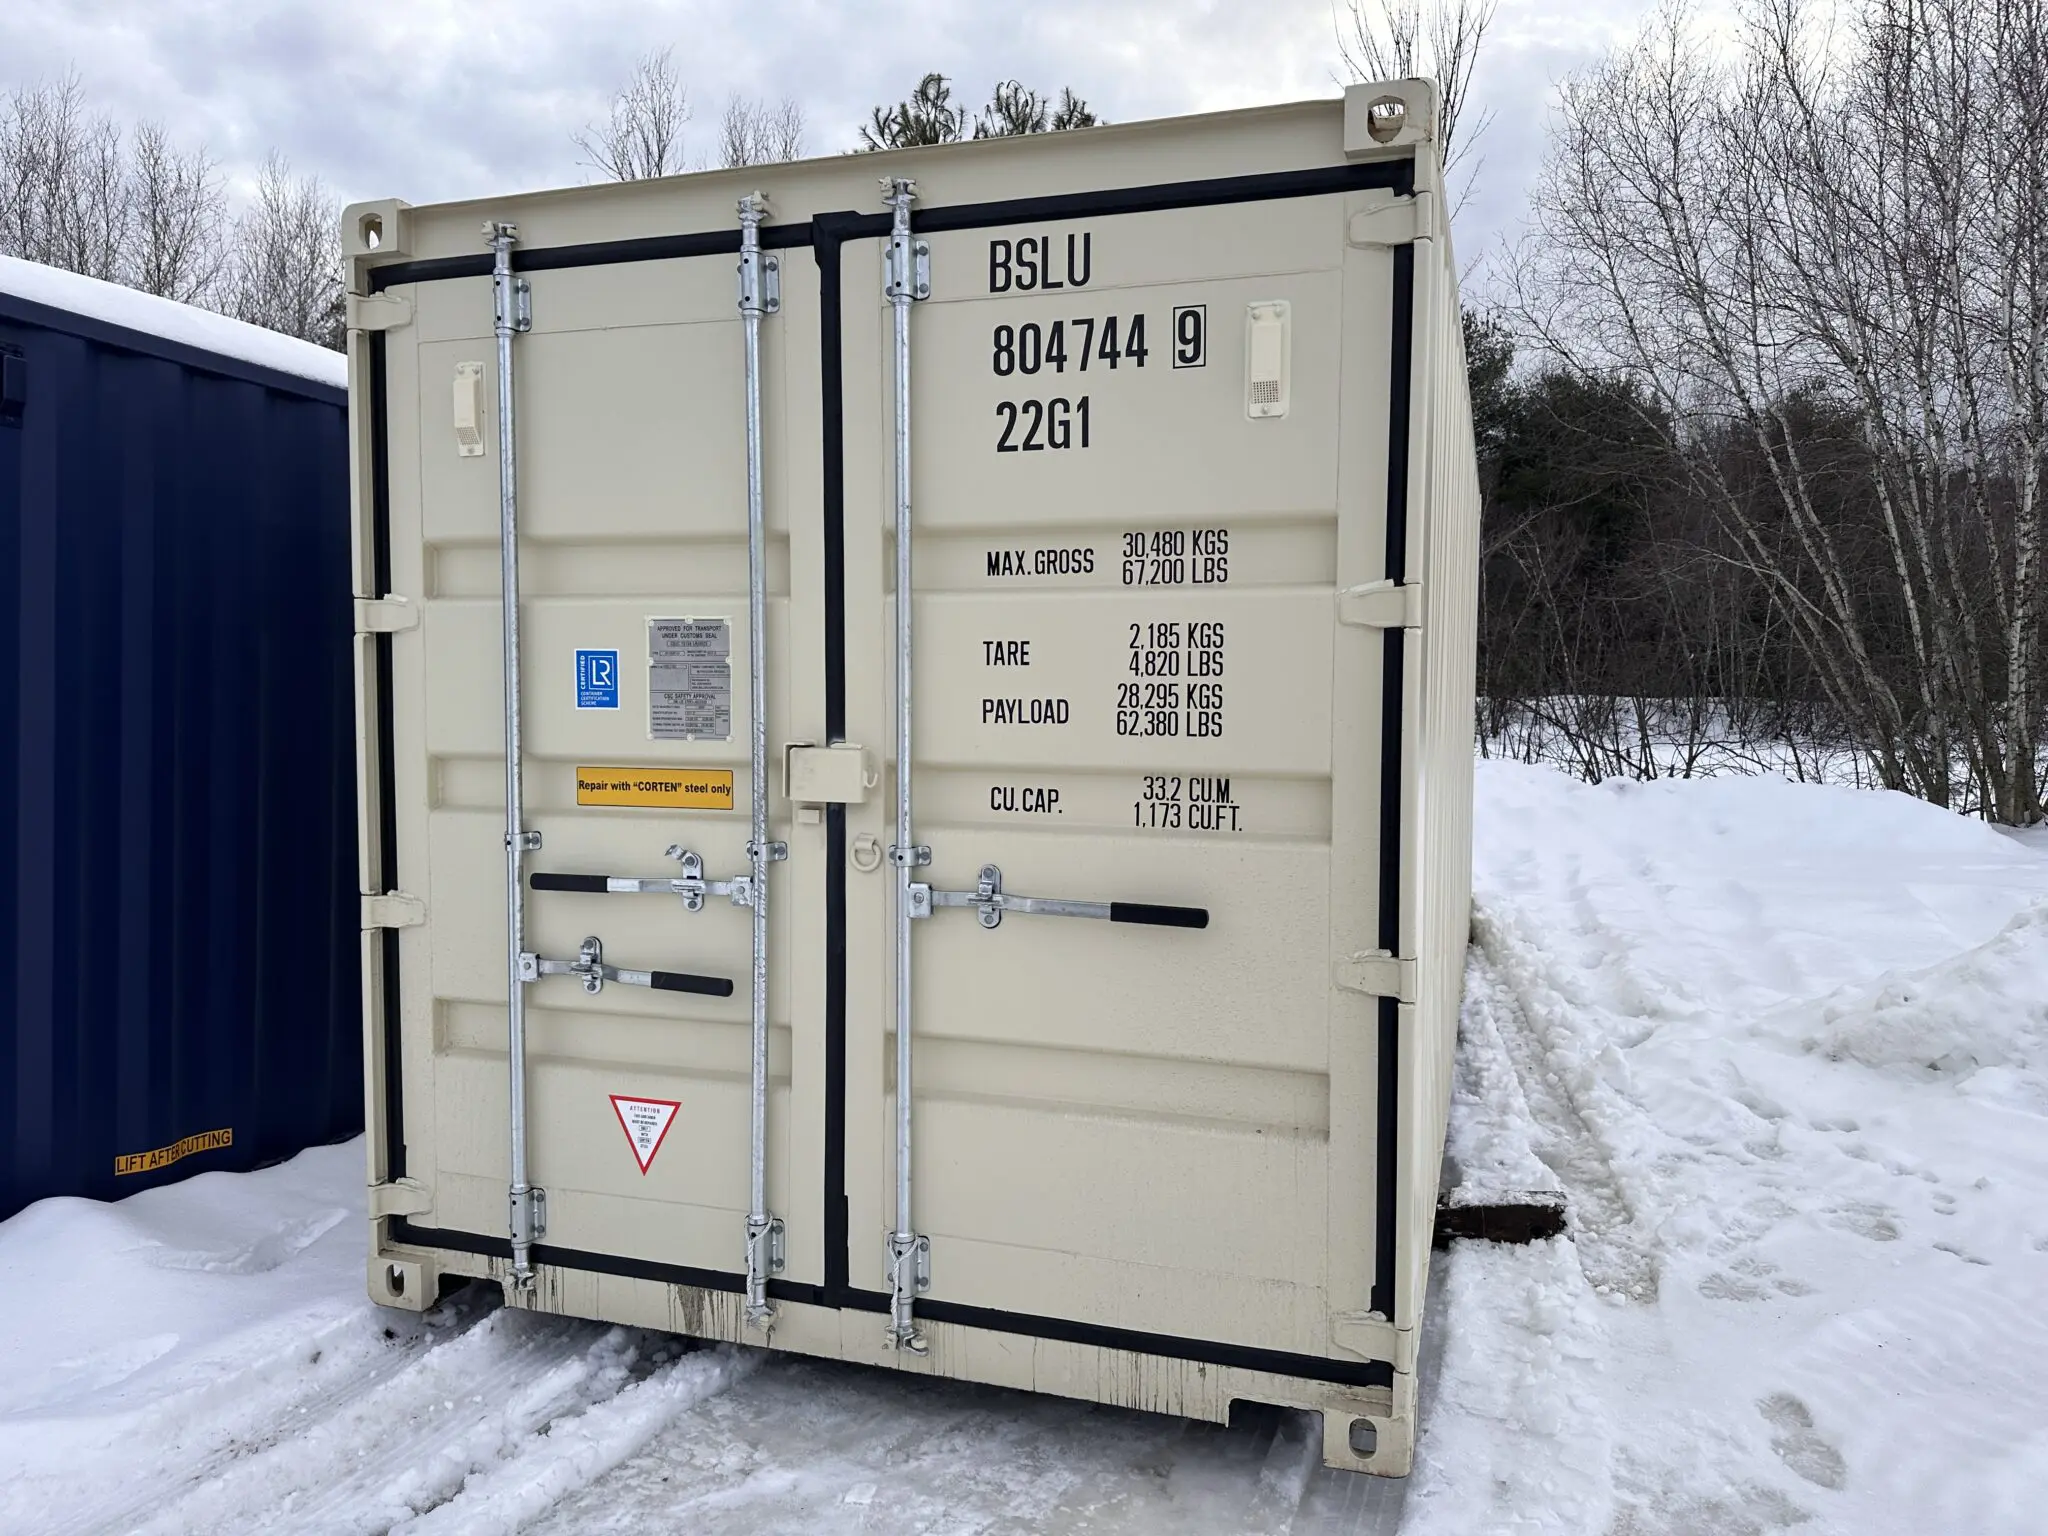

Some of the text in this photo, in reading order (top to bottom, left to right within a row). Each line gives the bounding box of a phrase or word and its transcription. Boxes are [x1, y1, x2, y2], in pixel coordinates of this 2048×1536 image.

[989, 232, 1091, 293] BSLU
[993, 309, 1202, 377] 804744 9
[996, 396, 1090, 452] 22G1
[1122, 529, 1229, 559] 30,480 KGS
[1122, 557, 1228, 585] 67,200 LBS
[1129, 622, 1224, 650] 2,185 KGS
[983, 640, 1031, 666] TARE
[1129, 650, 1224, 677] 4,820 LBS
[592, 659, 612, 686] LR
[1117, 683, 1223, 710] 28,295 KGS
[982, 698, 1070, 724] PAYLOAD
[1116, 711, 1223, 737] 62,380 LBS
[578, 779, 609, 792] Repair
[610, 780, 631, 791] with
[684, 782, 708, 793] steel
[711, 783, 732, 796] only
[1142, 776, 1234, 803] 33.2 CU.M.
[1134, 802, 1243, 831] 1,173 CU.FT.
[629, 1105, 661, 1114] ATTENTION
[116, 1130, 231, 1173] LIFT AFTER CUTTING
